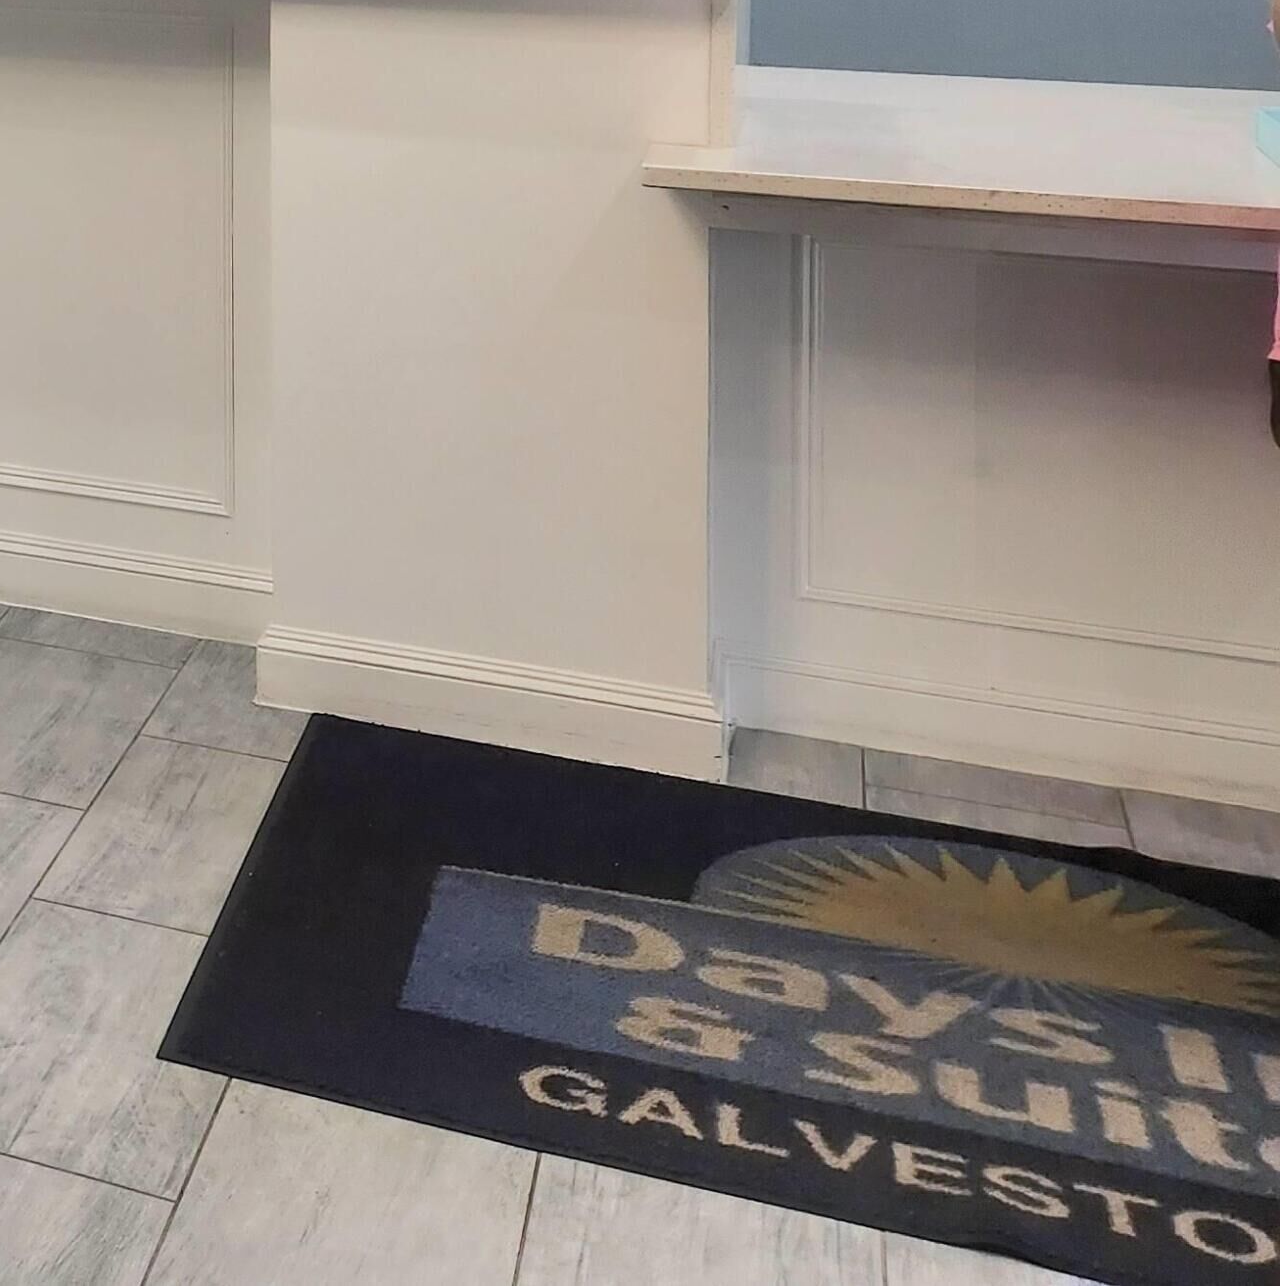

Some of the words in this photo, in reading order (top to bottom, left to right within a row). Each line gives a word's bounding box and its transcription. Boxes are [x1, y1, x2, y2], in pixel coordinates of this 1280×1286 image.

[531, 902, 1116, 1064] Days
[615, 996, 755, 1061] &
[518, 1064, 1278, 1264] GALVESTO
